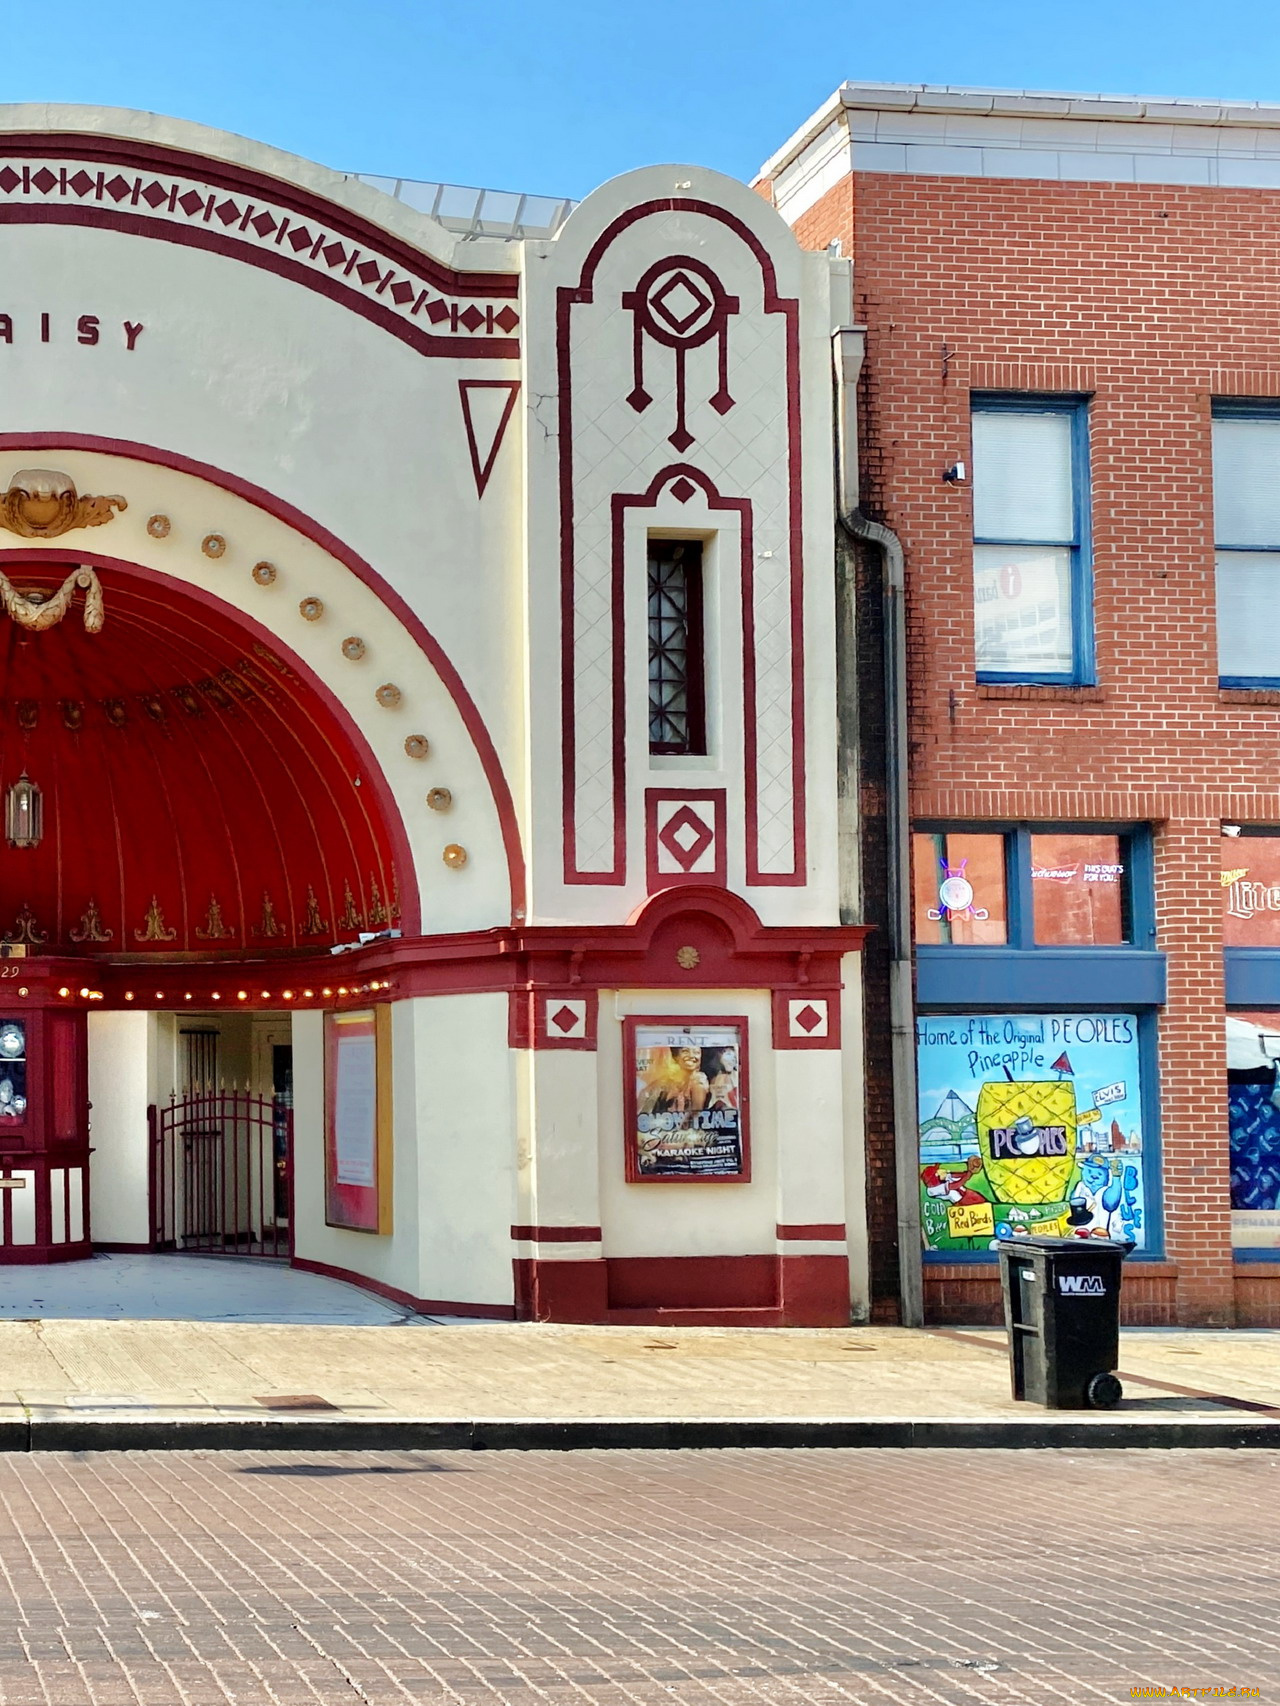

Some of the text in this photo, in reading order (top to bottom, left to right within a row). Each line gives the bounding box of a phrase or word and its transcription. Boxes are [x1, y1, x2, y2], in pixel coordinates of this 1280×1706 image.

[1227, 881, 1280, 919] Lite
[666, 1036, 709, 1046] RENT
[917, 1018, 1134, 1049] Home of the Original PEOPLES
[968, 1047, 1045, 1078] Pineapple
[1094, 1085, 1122, 1104] ELVIS
[691, 1110, 737, 1129] TIME
[656, 1145, 736, 1157] KARAOKE NIGHT
[948, 1207, 965, 1218] GO
[954, 1210, 992, 1229] Red Birds
[1058, 1275, 1106, 1293] WM
